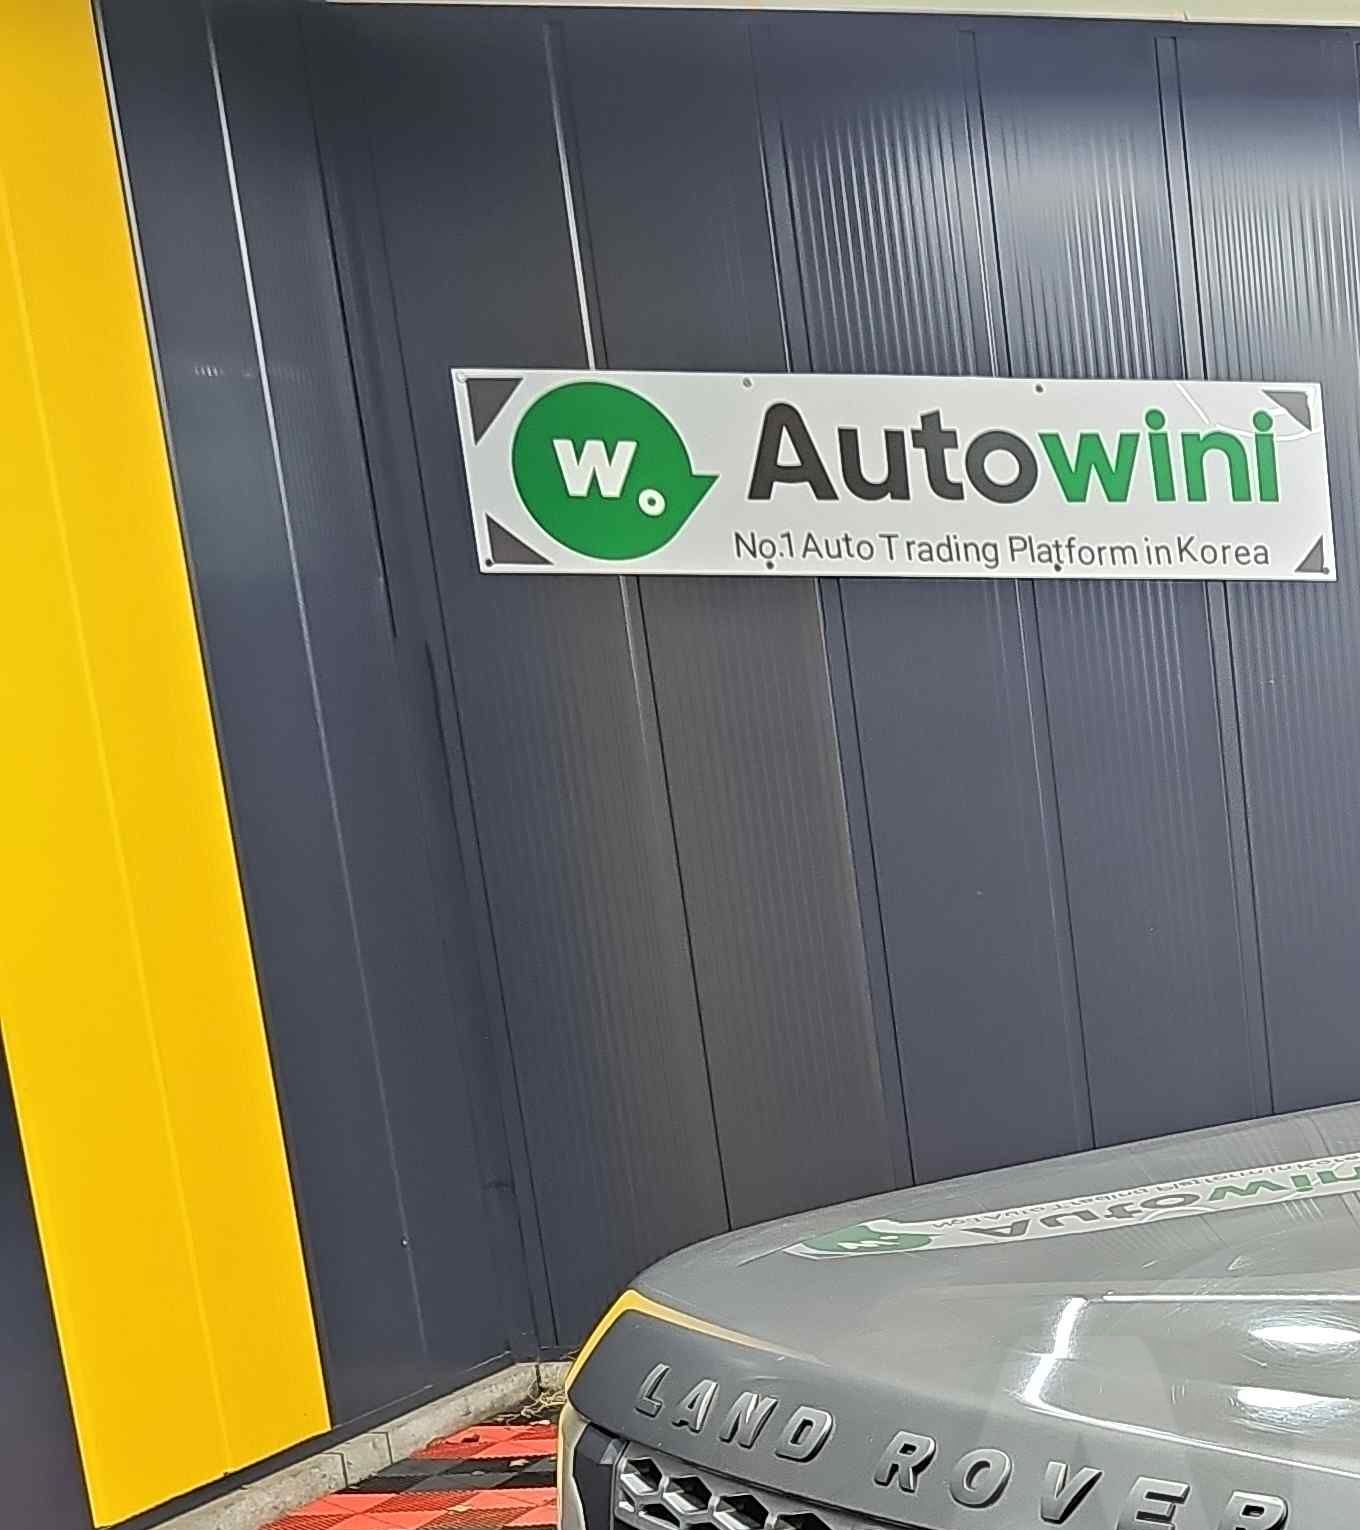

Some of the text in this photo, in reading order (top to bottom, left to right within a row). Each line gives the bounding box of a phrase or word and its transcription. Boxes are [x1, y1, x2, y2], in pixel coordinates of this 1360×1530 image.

[747, 402, 1279, 503] Autowini
[733, 531, 1270, 569] No.1 Auto Trading Platform in Korea
[635, 1363, 835, 1463] LAND
